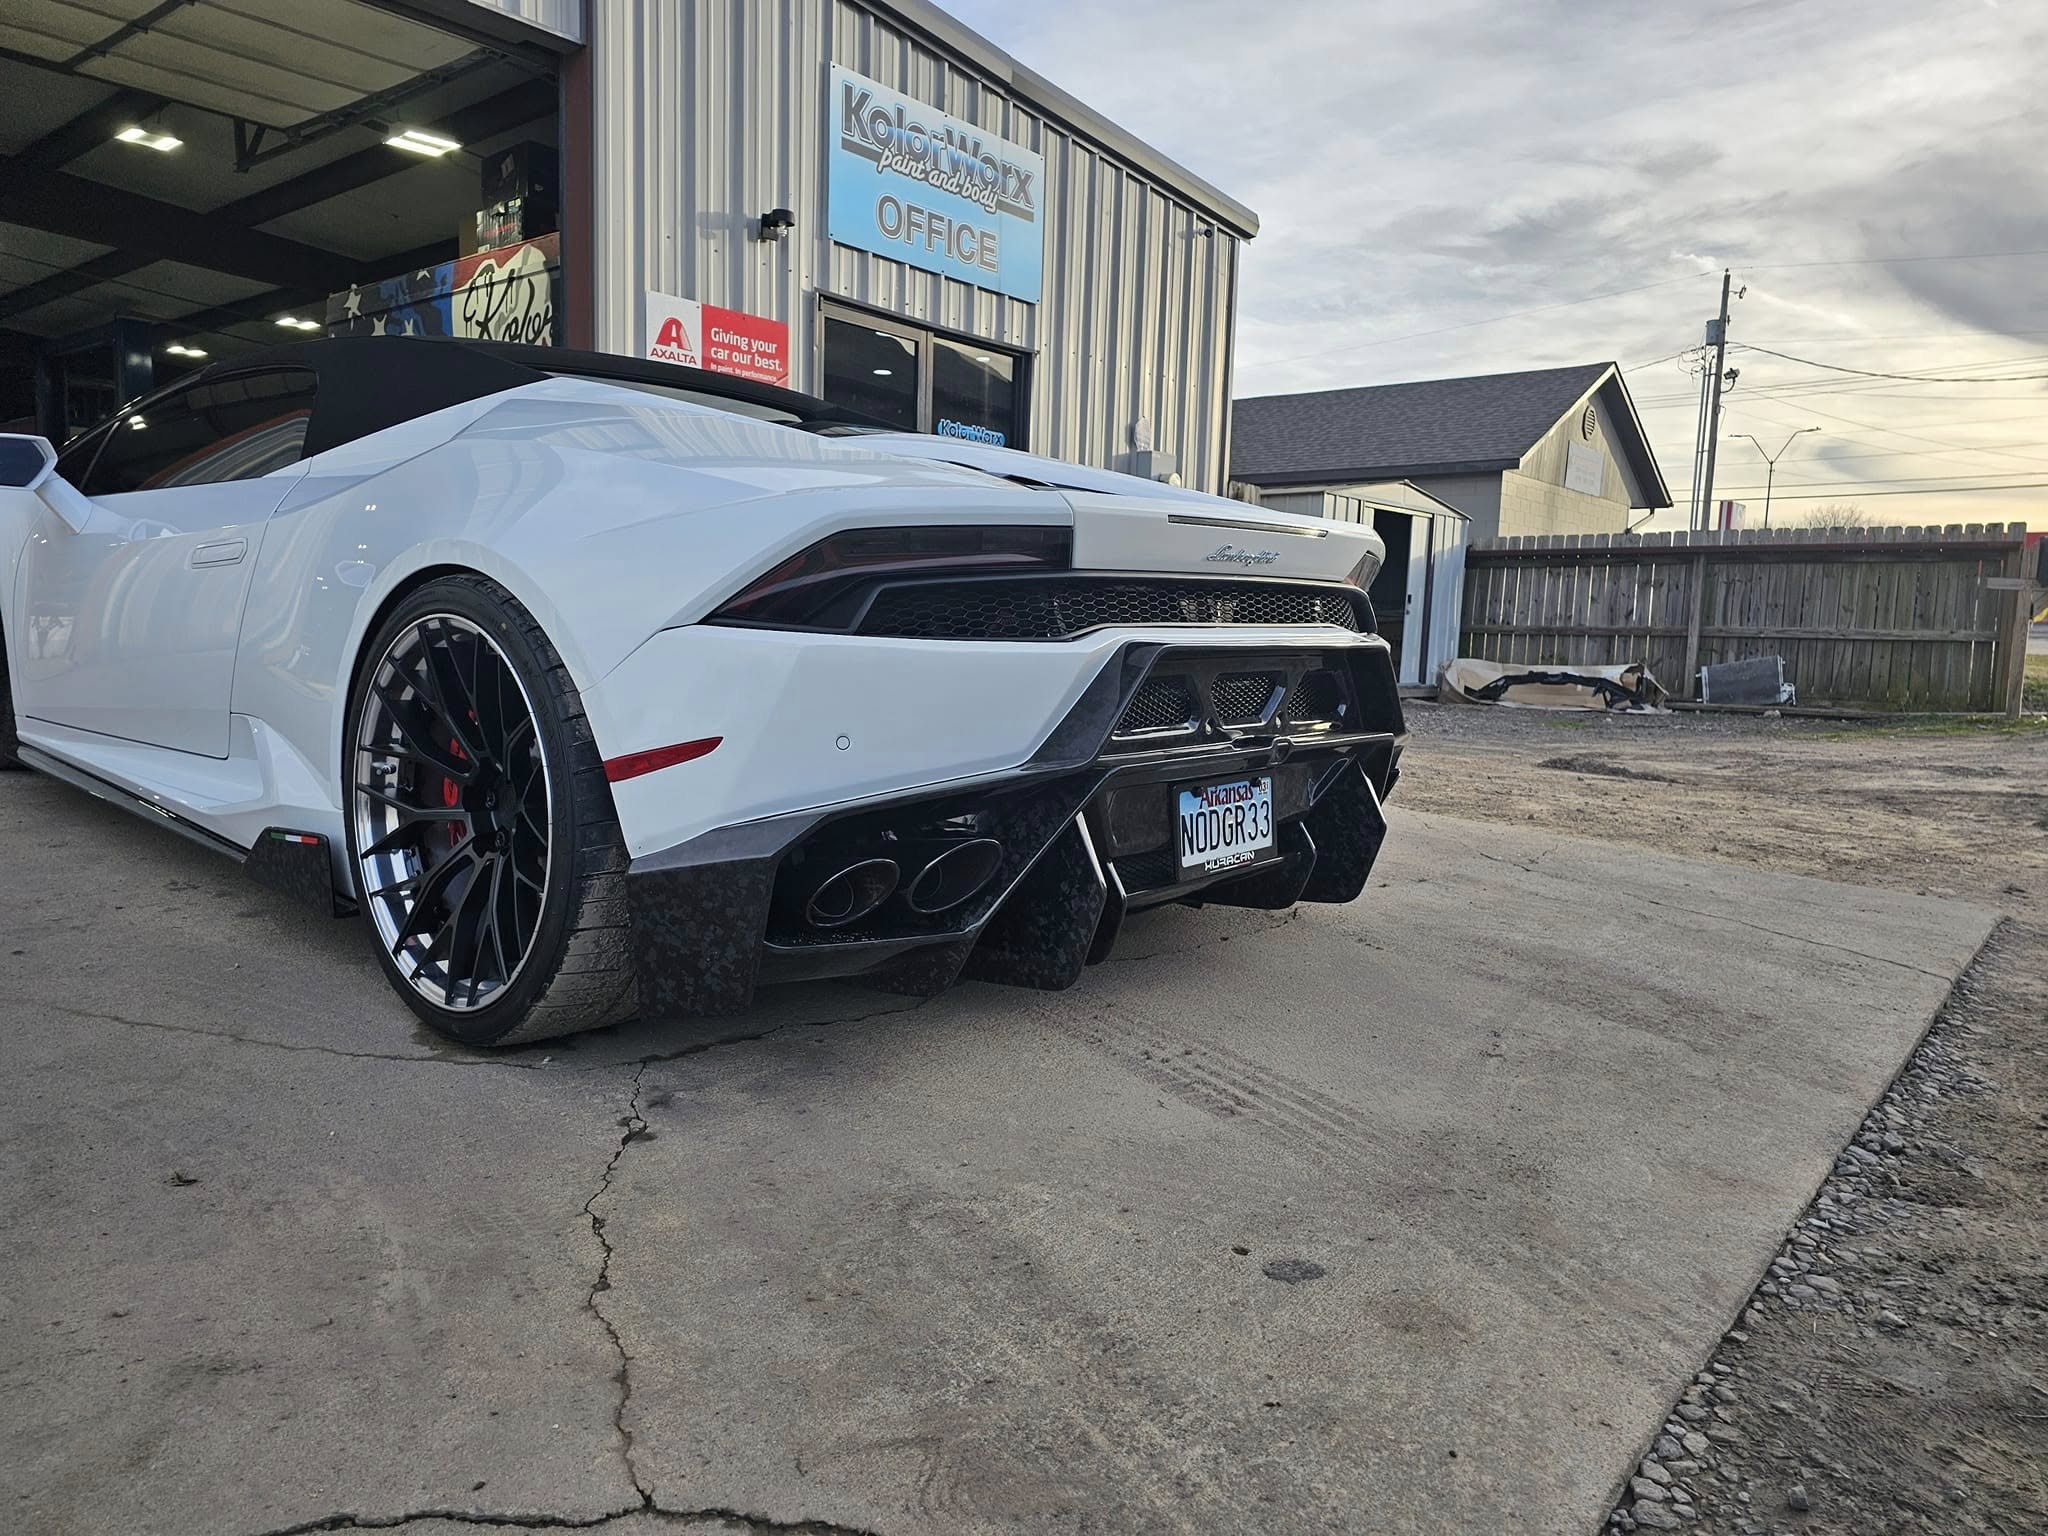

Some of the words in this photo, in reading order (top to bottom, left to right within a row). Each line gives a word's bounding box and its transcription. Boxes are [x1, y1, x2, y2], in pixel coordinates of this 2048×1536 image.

[841, 80, 1034, 209] KolorWorx
[877, 147, 928, 181] paint
[928, 166, 960, 194] and
[962, 177, 1000, 214] body
[876, 193, 998, 272] OFFICE
[710, 327, 748, 351] Giving
[751, 338, 777, 354] your
[650, 347, 697, 365] AXALTA
[710, 347, 729, 360] car
[732, 351, 752, 365] our
[755, 353, 782, 372] best.
[1200, 784, 1253, 809] Arkansas
[1181, 799, 1270, 857] NODGR33
[1205, 851, 1255, 871] HURACAN
